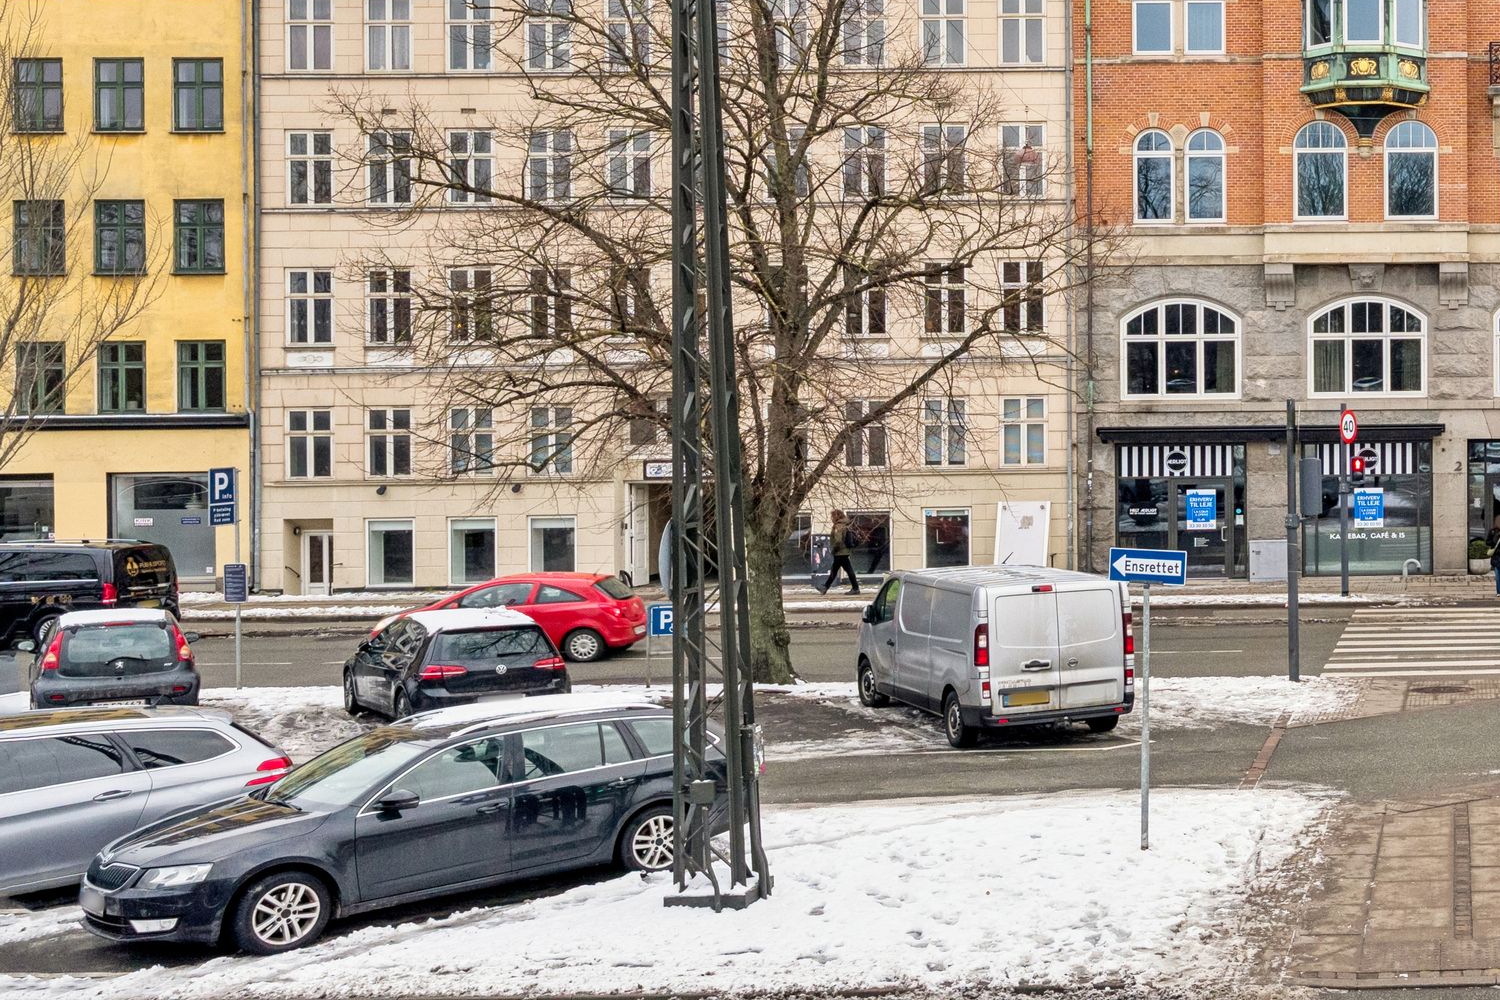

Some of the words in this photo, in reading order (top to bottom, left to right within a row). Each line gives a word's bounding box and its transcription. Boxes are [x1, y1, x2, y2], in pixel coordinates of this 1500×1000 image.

[1343, 420, 1354, 432] 40
[1454, 461, 1462, 472] 2
[215, 472, 229, 500] P
[1125, 560, 1180, 574] Ensrettet
[660, 610, 673, 630] P
